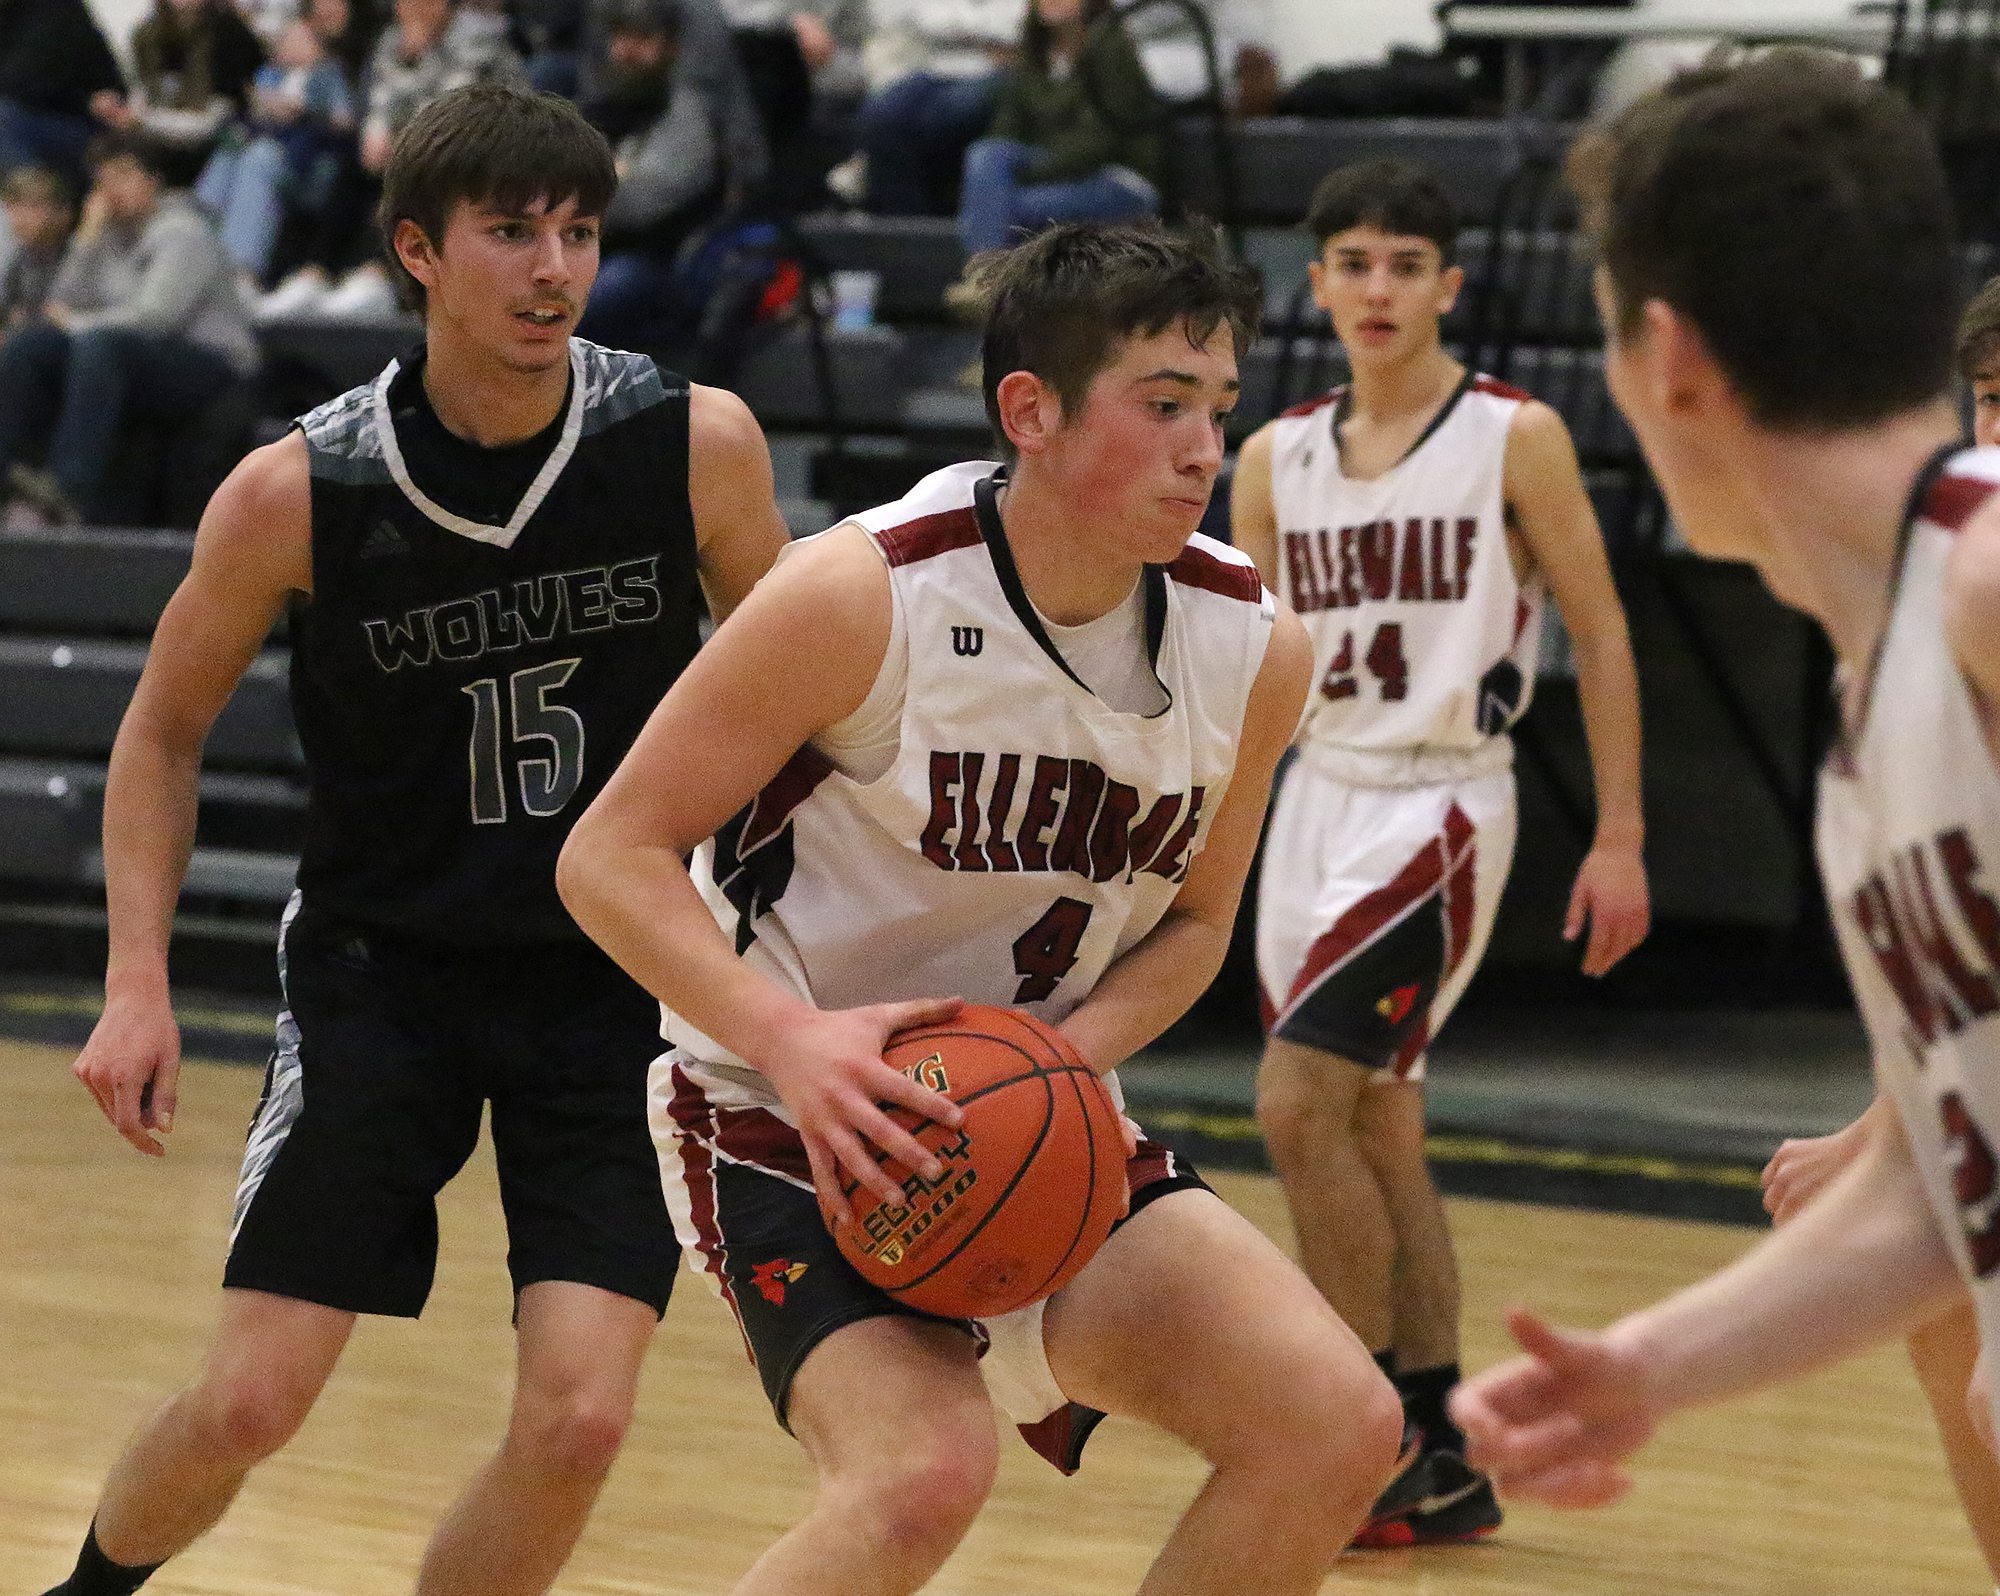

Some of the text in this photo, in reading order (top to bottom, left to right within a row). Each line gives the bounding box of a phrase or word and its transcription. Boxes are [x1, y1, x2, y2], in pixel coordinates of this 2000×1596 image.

[363, 555, 661, 672] WOLVES
[460, 657, 584, 824] 15
[920, 750, 1206, 885] ELLENDE
[1012, 896, 1093, 1005] 4
[902, 1168, 977, 1245] 1000
